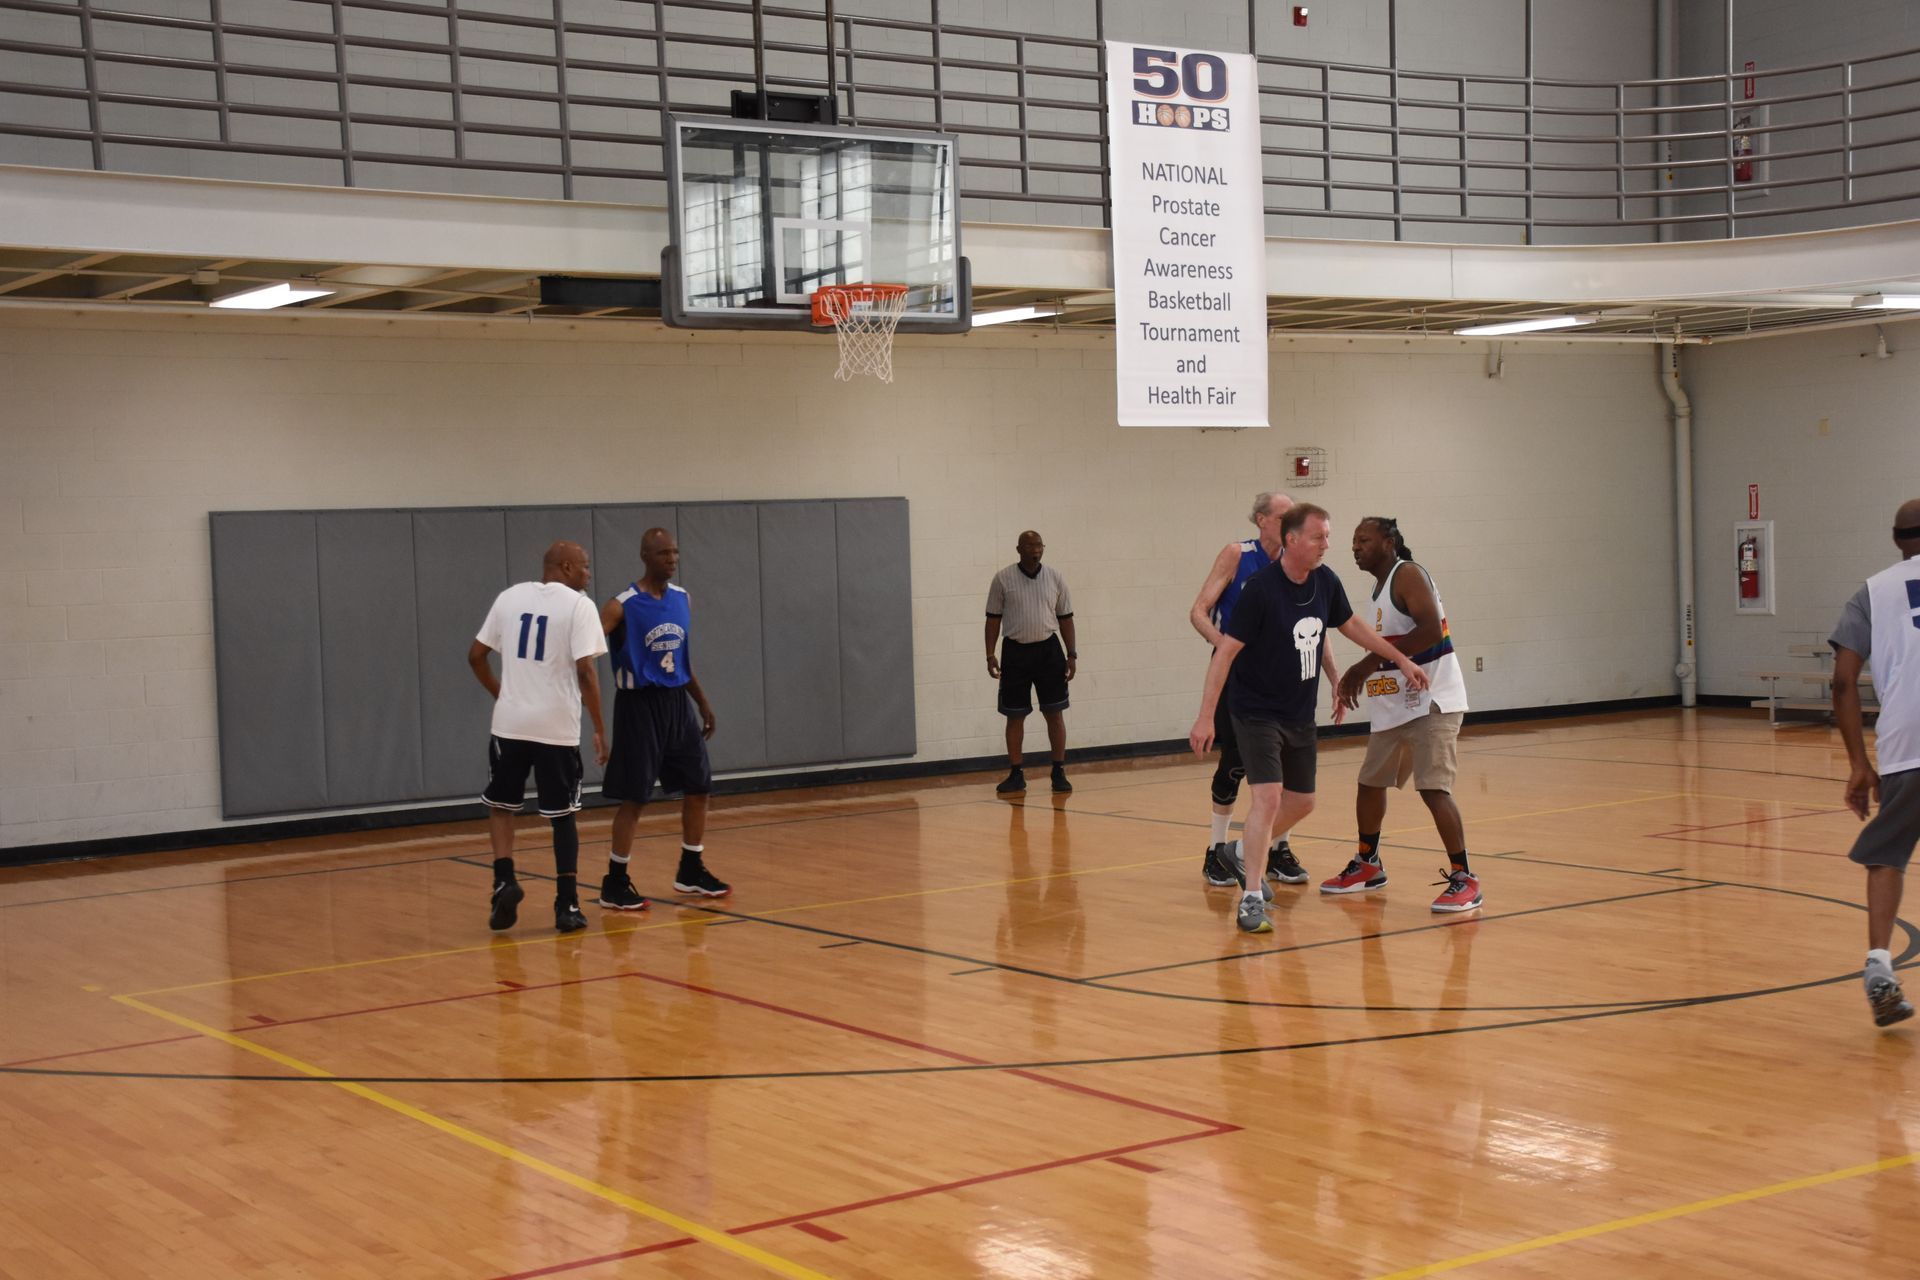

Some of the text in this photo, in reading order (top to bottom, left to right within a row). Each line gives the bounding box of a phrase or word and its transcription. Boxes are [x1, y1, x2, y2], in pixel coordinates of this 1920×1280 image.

[1132, 47, 1228, 103] 50
[1137, 102, 1228, 130] HOOPS
[1142, 162, 1228, 186] NATIONAL
[1152, 194, 1220, 217] Prostate
[1159, 226, 1216, 247] Cancer
[1143, 258, 1233, 280] Awareness
[1148, 290, 1231, 311] Basketball
[1139, 322, 1241, 343] Tournament
[1176, 354, 1207, 374] and
[1148, 385, 1237, 405] Health Fair
[517, 612, 549, 661] 11
[660, 651, 675, 673] 4
